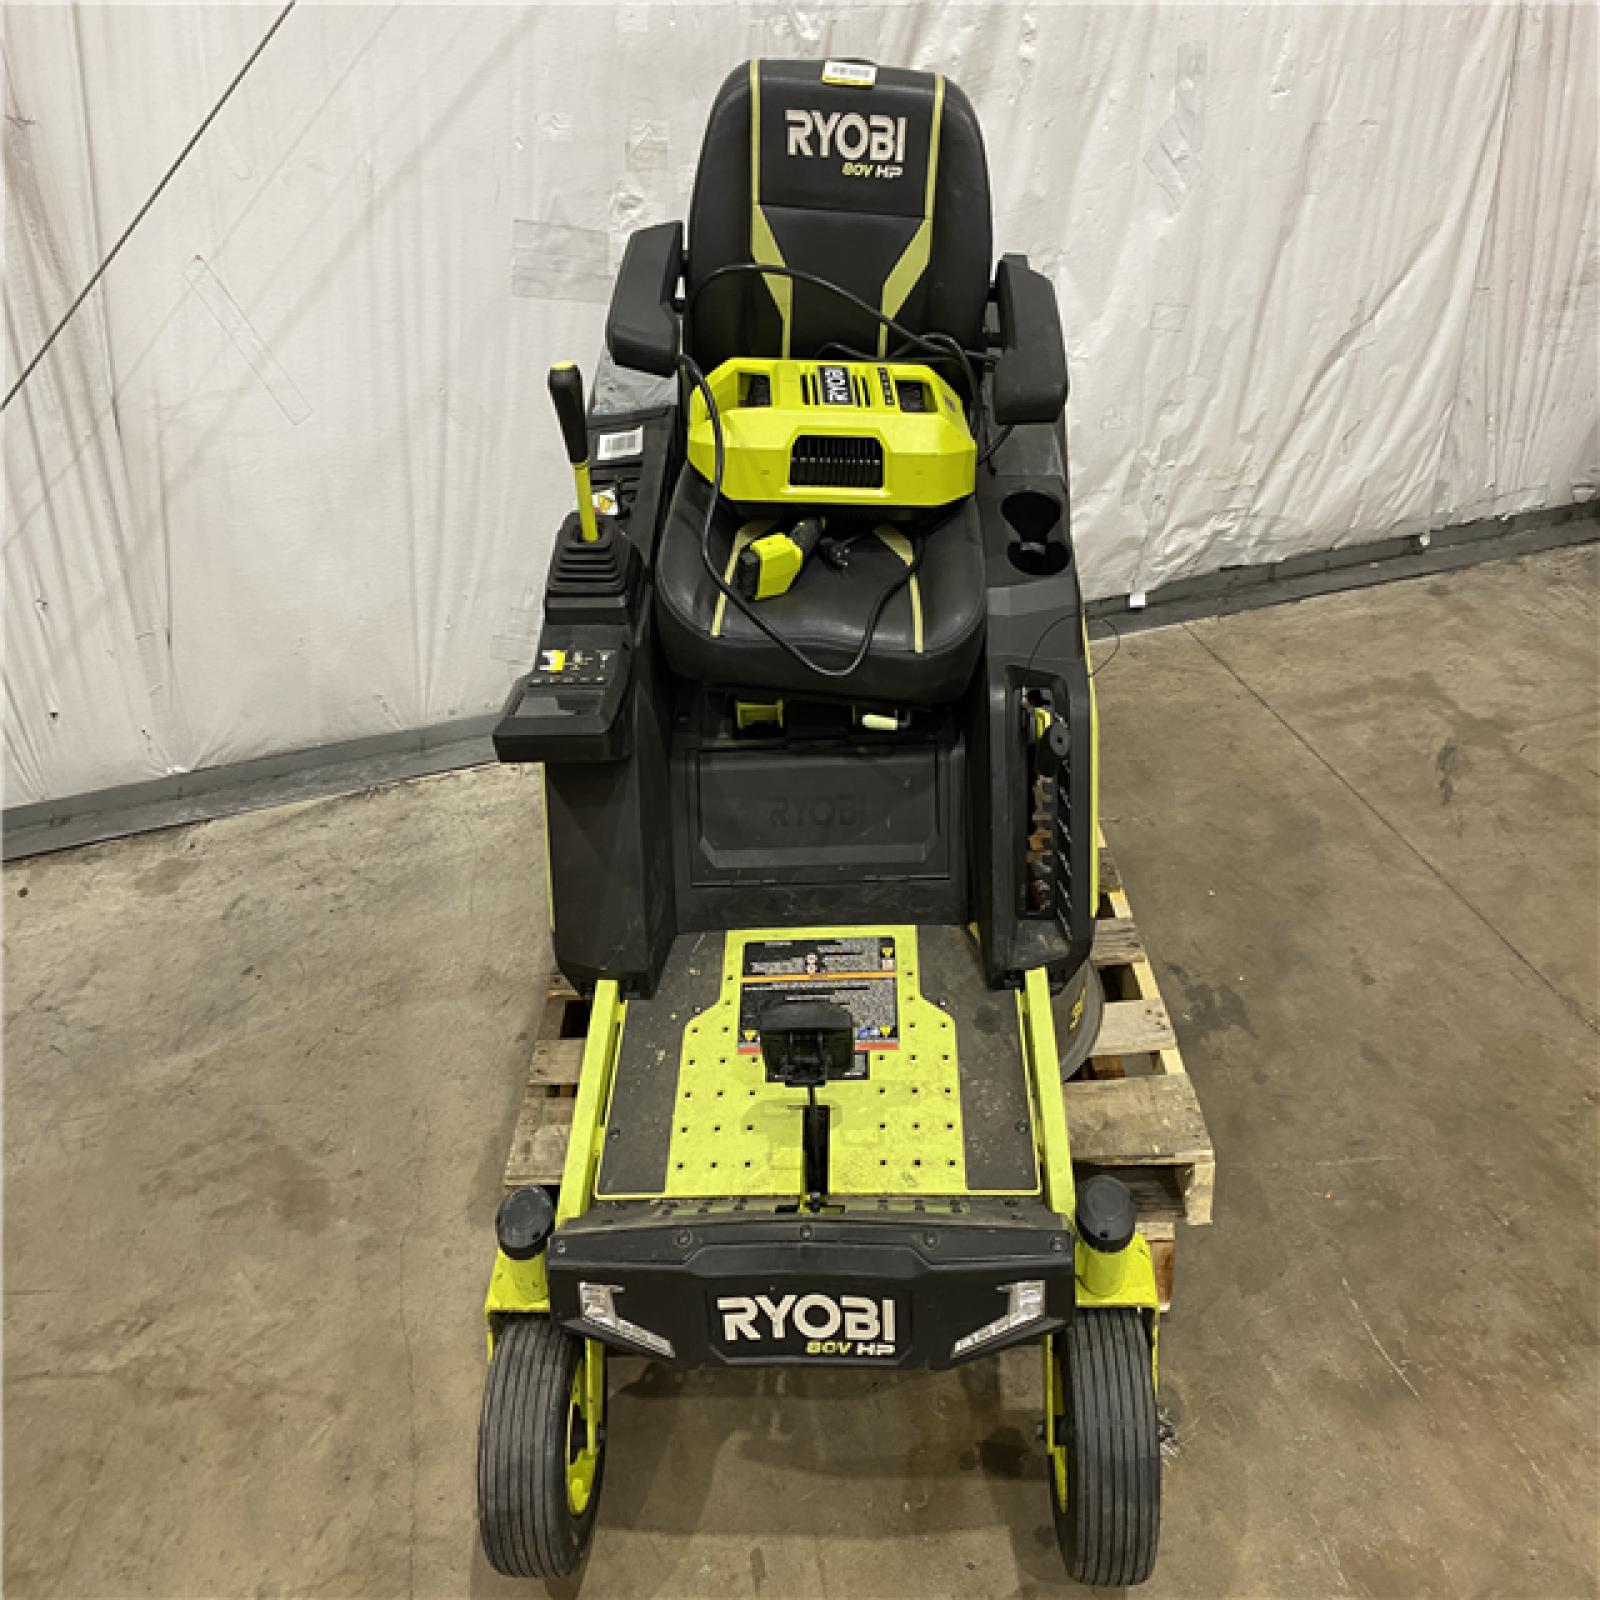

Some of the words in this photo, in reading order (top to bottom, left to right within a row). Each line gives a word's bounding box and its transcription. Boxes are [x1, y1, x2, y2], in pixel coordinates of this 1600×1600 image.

[785, 109, 907, 162] RYOBI
[875, 165, 903, 179] HP
[824, 367, 849, 402] RYOBI
[768, 795, 867, 827] RYOBI
[717, 1294, 896, 1341] RYOBI
[805, 1340, 853, 1355] 80V
[856, 1343, 896, 1355] HP
